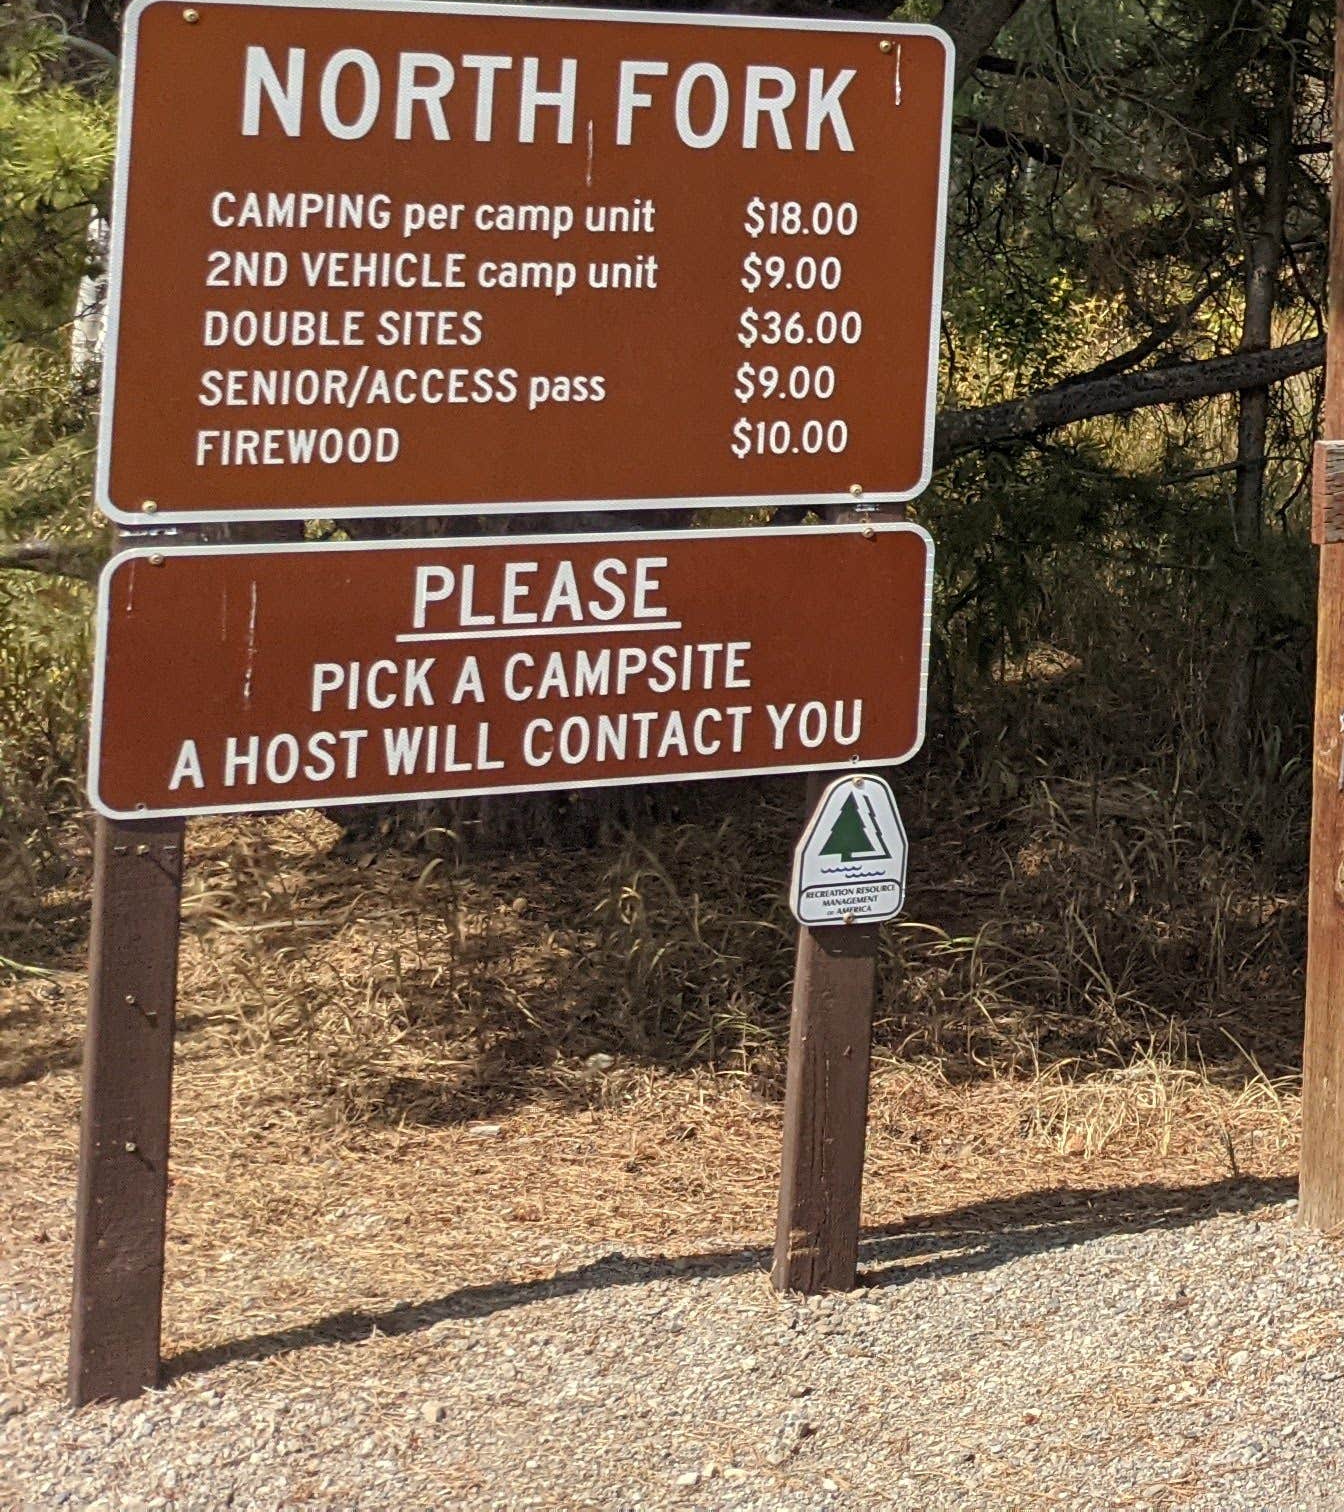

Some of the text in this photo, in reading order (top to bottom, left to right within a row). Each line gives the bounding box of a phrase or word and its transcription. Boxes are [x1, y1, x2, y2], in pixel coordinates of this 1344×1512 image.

[241, 46, 857, 152] NORTH FORK
[211, 191, 858, 239] CAMPING per camp unit $18.00
[207, 251, 841, 295] 2ND VEHICLE camp unit $9.00
[204, 309, 862, 348] DOUBLE SITES $36.00
[200, 364, 835, 410] SENIOR/ACCESS pass $9.00
[197, 418, 848, 467] FIREWOOD $10.00
[412, 556, 669, 629] PLEASE
[310, 641, 752, 713] PICK A CAMPSITE
[168, 699, 863, 791] A HOST WILL CONTACT YOU
[806, 884, 896, 899] RECREATION RESOURCE
[822, 895, 878, 907] MANAGEMENT
[836, 905, 872, 915] AMERICA
